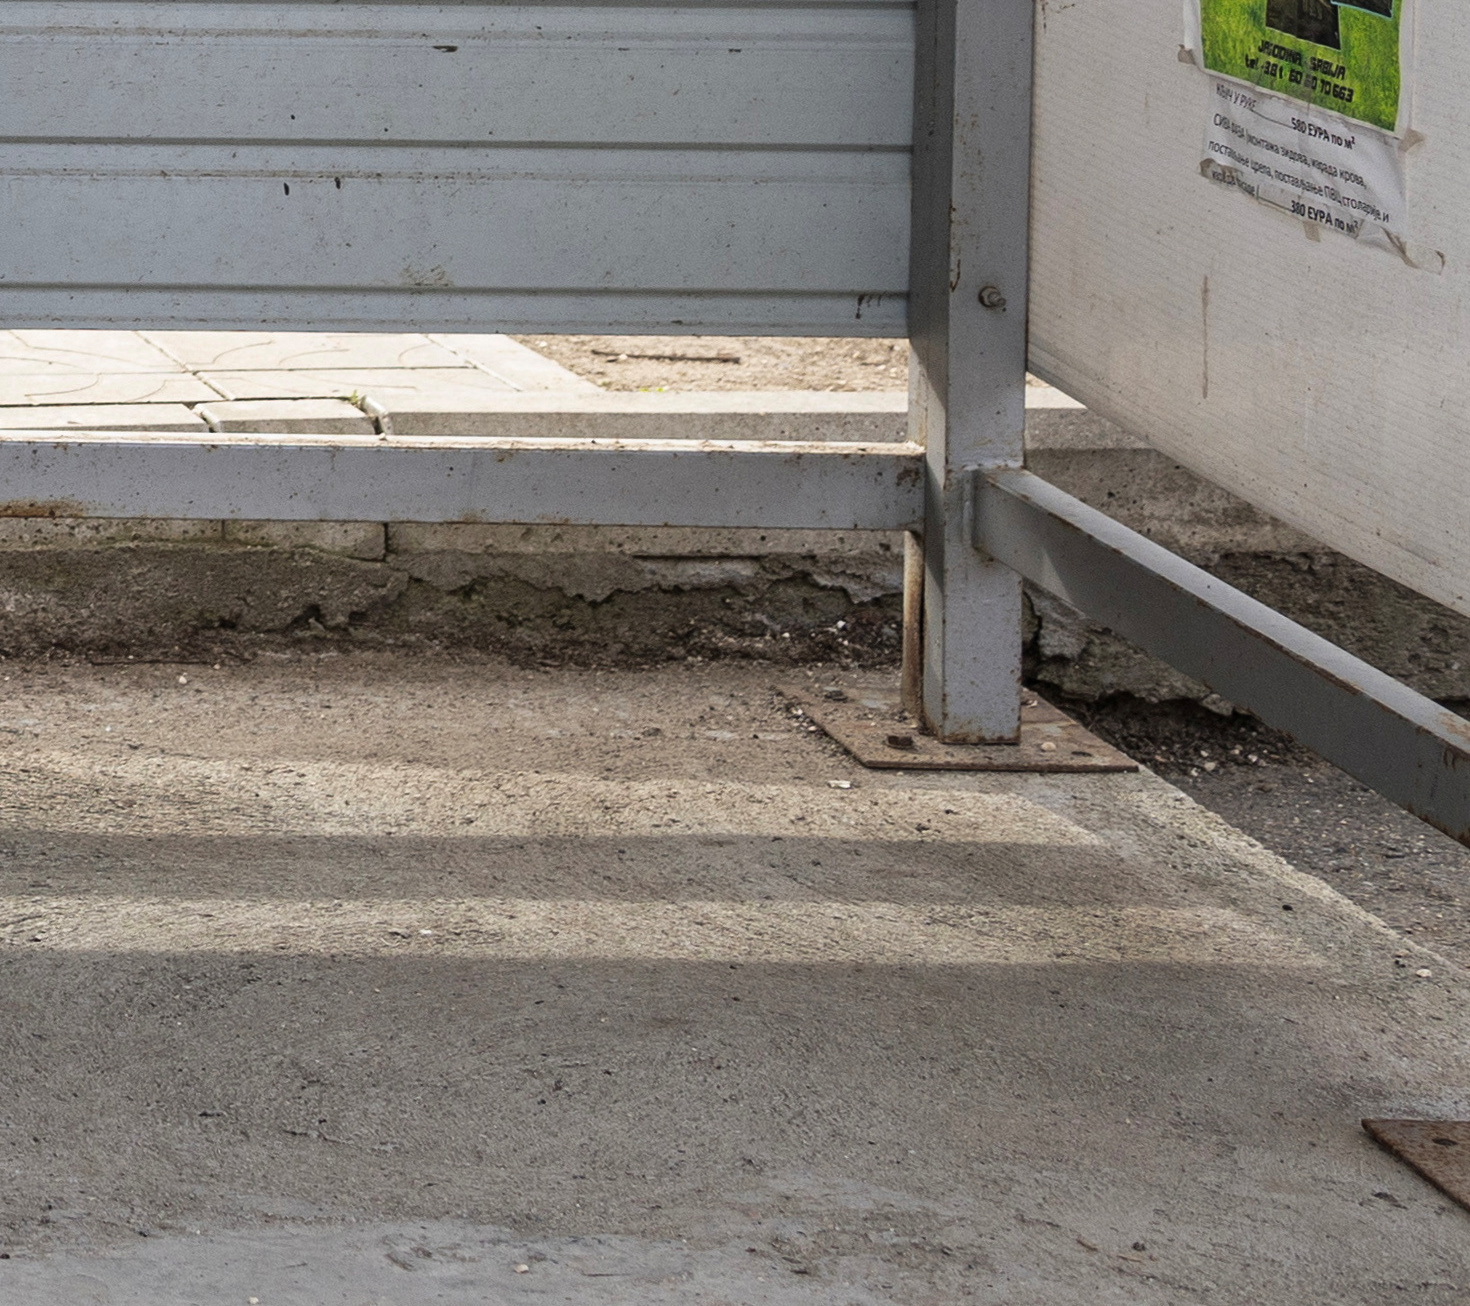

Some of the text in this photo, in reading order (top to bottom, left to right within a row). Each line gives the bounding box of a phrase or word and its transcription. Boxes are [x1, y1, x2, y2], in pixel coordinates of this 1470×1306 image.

[1291, 118, 1306, 134] 580
[1308, 123, 1330, 141] ЕУРА
[1332, 136, 1342, 146] по
